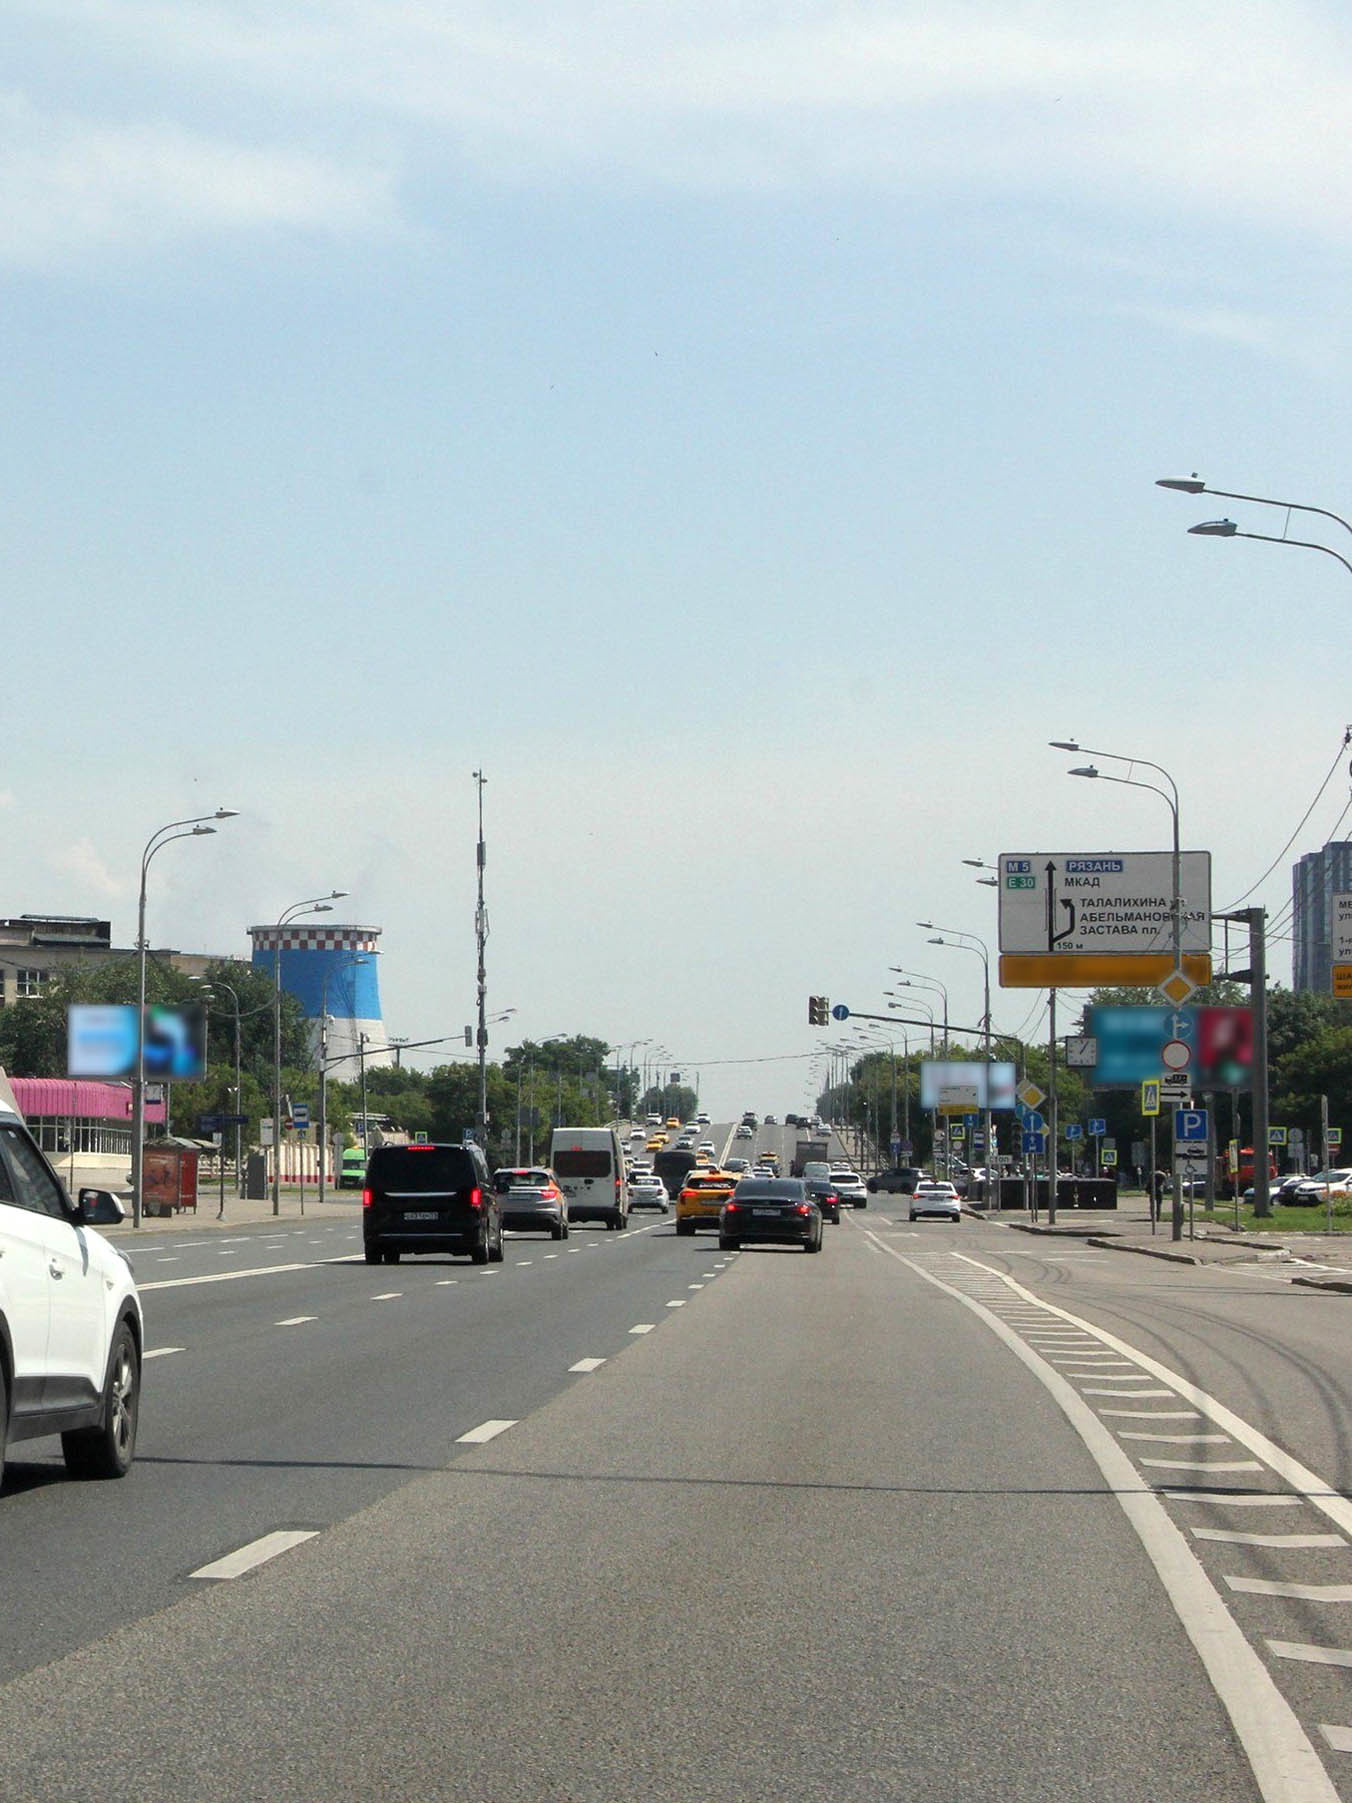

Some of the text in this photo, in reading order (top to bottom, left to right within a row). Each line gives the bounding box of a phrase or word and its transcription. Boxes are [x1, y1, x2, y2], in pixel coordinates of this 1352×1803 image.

[1008, 862, 1030, 872] М 5
[1068, 862, 1121, 872] РЯЗАНЬ
[1020, 877, 1035, 887] 30
[1064, 878, 1101, 887] МКАД
[1080, 898, 1166, 907] ТАЛАЛИХИНА
[1079, 926, 1138, 935] ЗАСТАВА
[1056, 942, 1073, 950] 150
